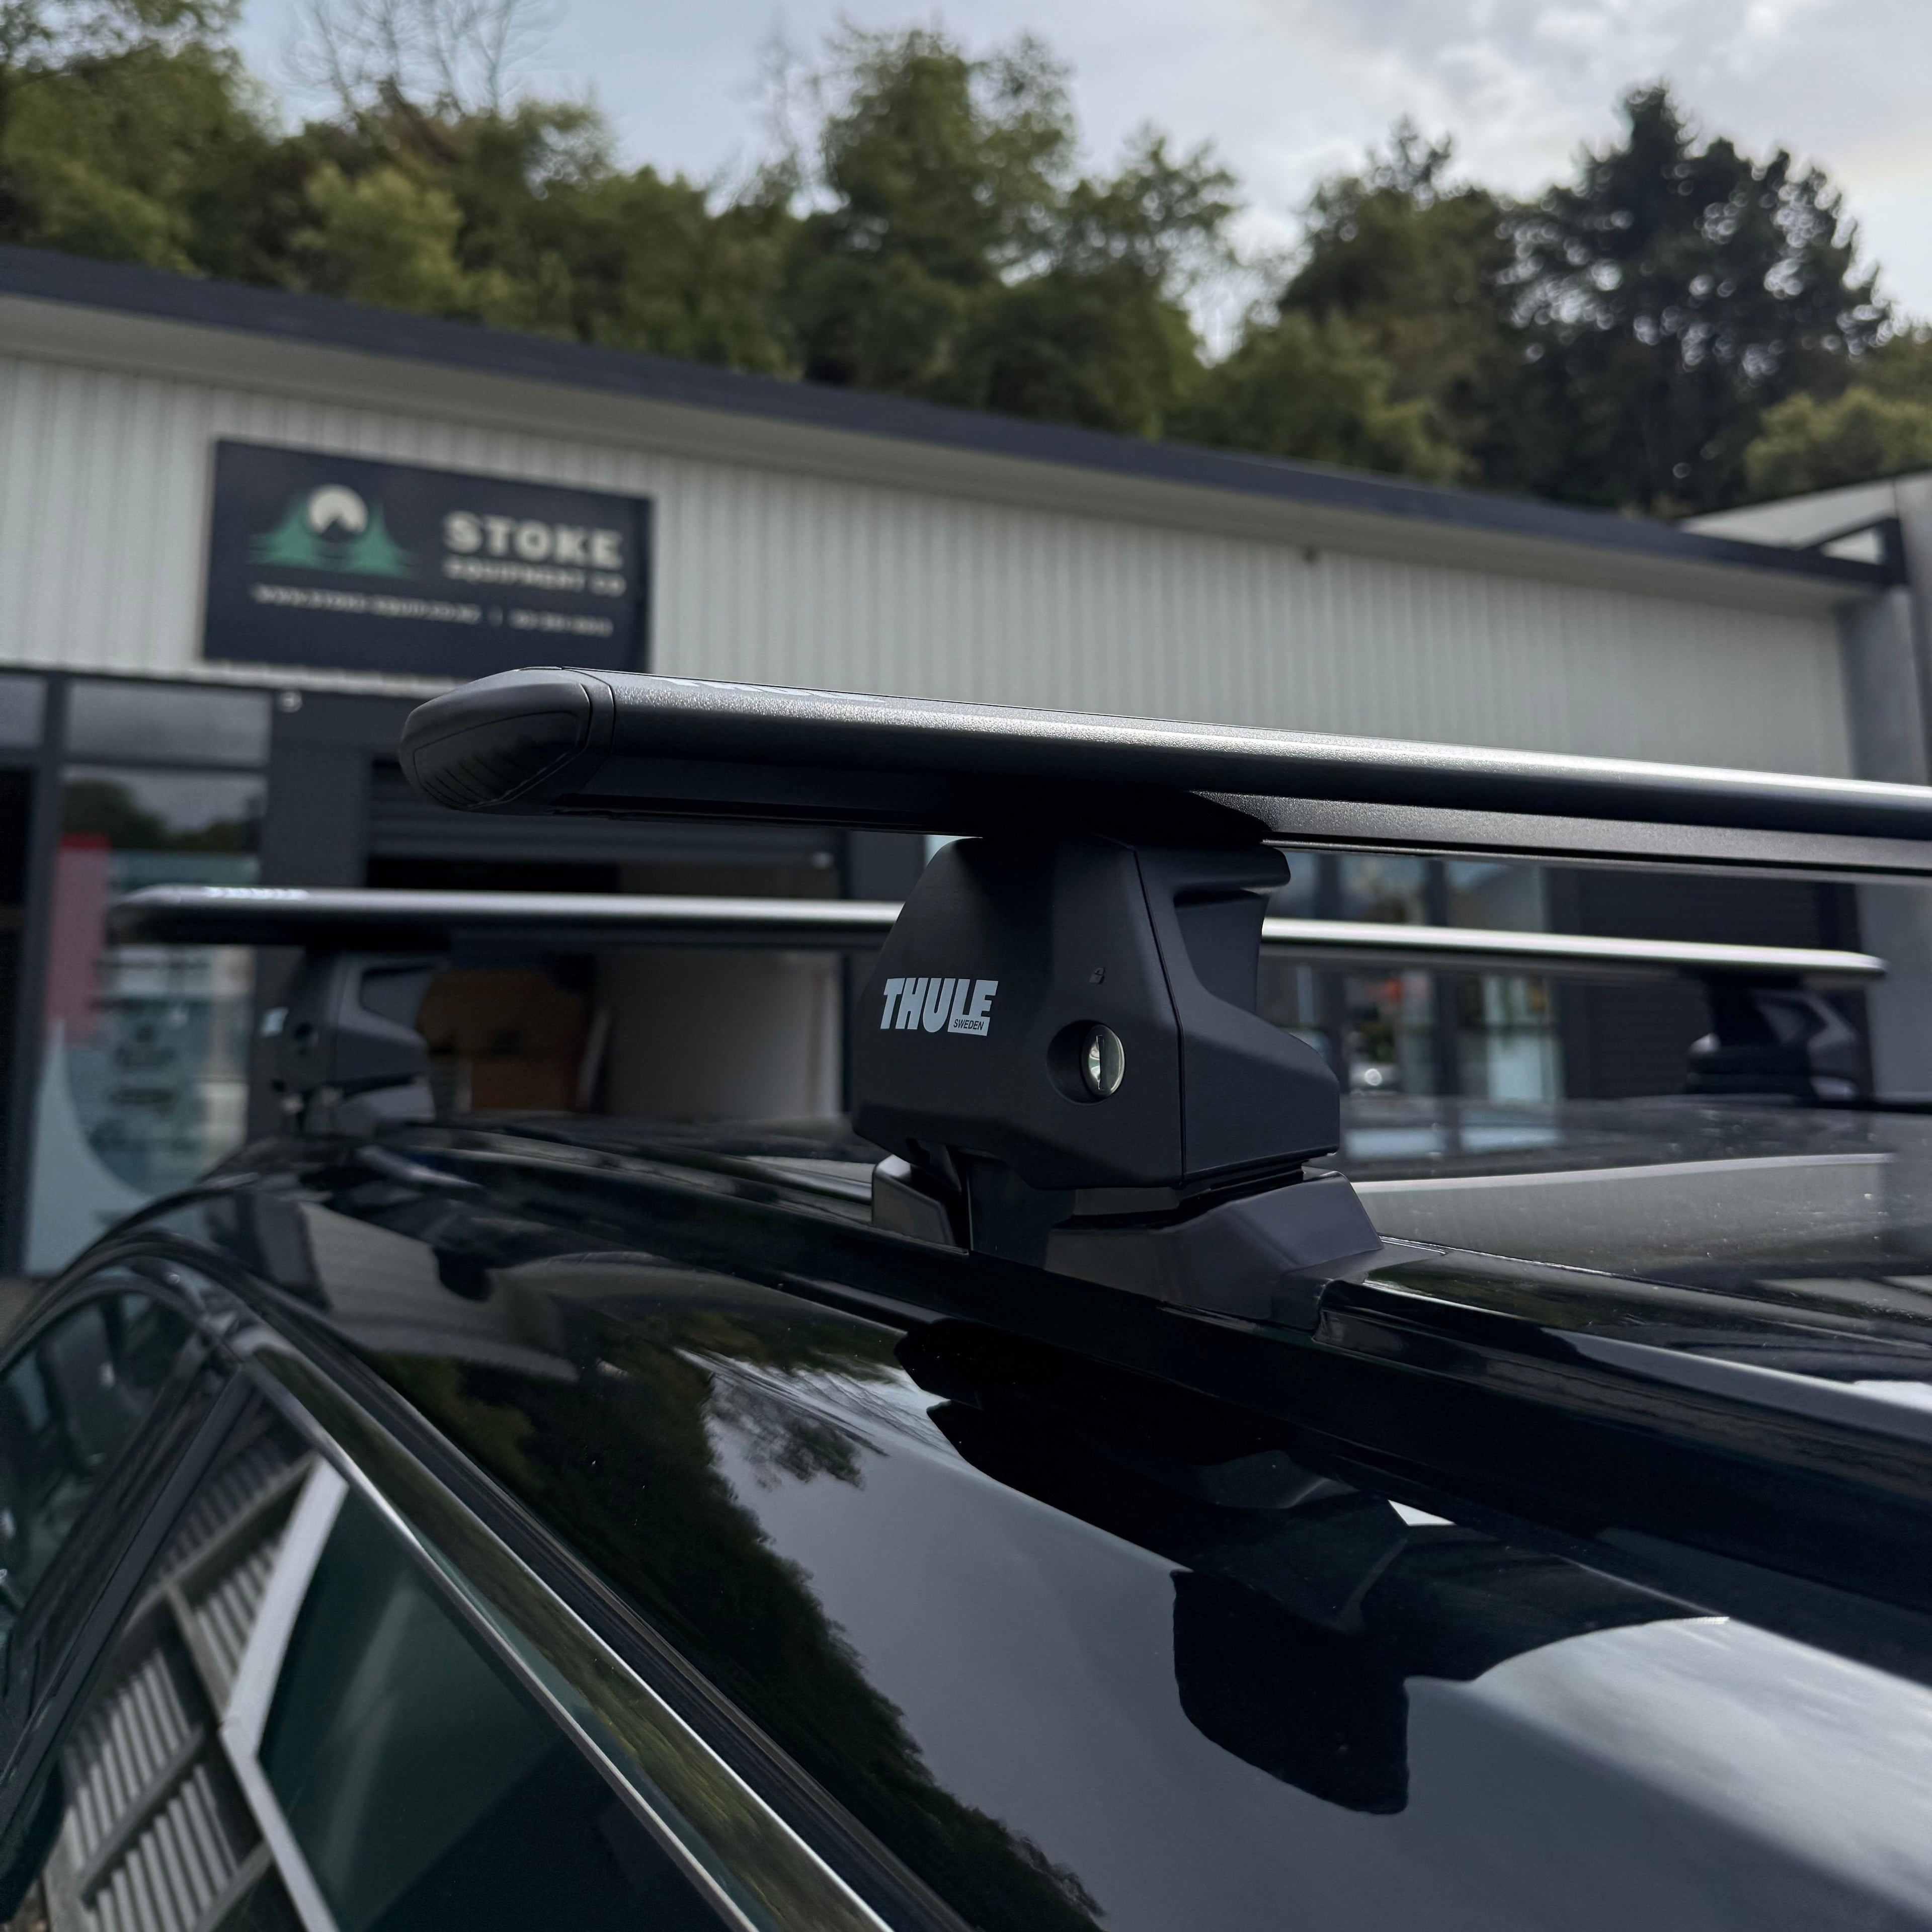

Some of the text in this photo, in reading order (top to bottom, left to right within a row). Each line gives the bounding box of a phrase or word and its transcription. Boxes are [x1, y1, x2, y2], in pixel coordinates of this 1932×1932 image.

[444, 511, 622, 570] STOKE
[880, 978, 999, 1035] THULE
[953, 1019, 984, 1030] SWEDEN
